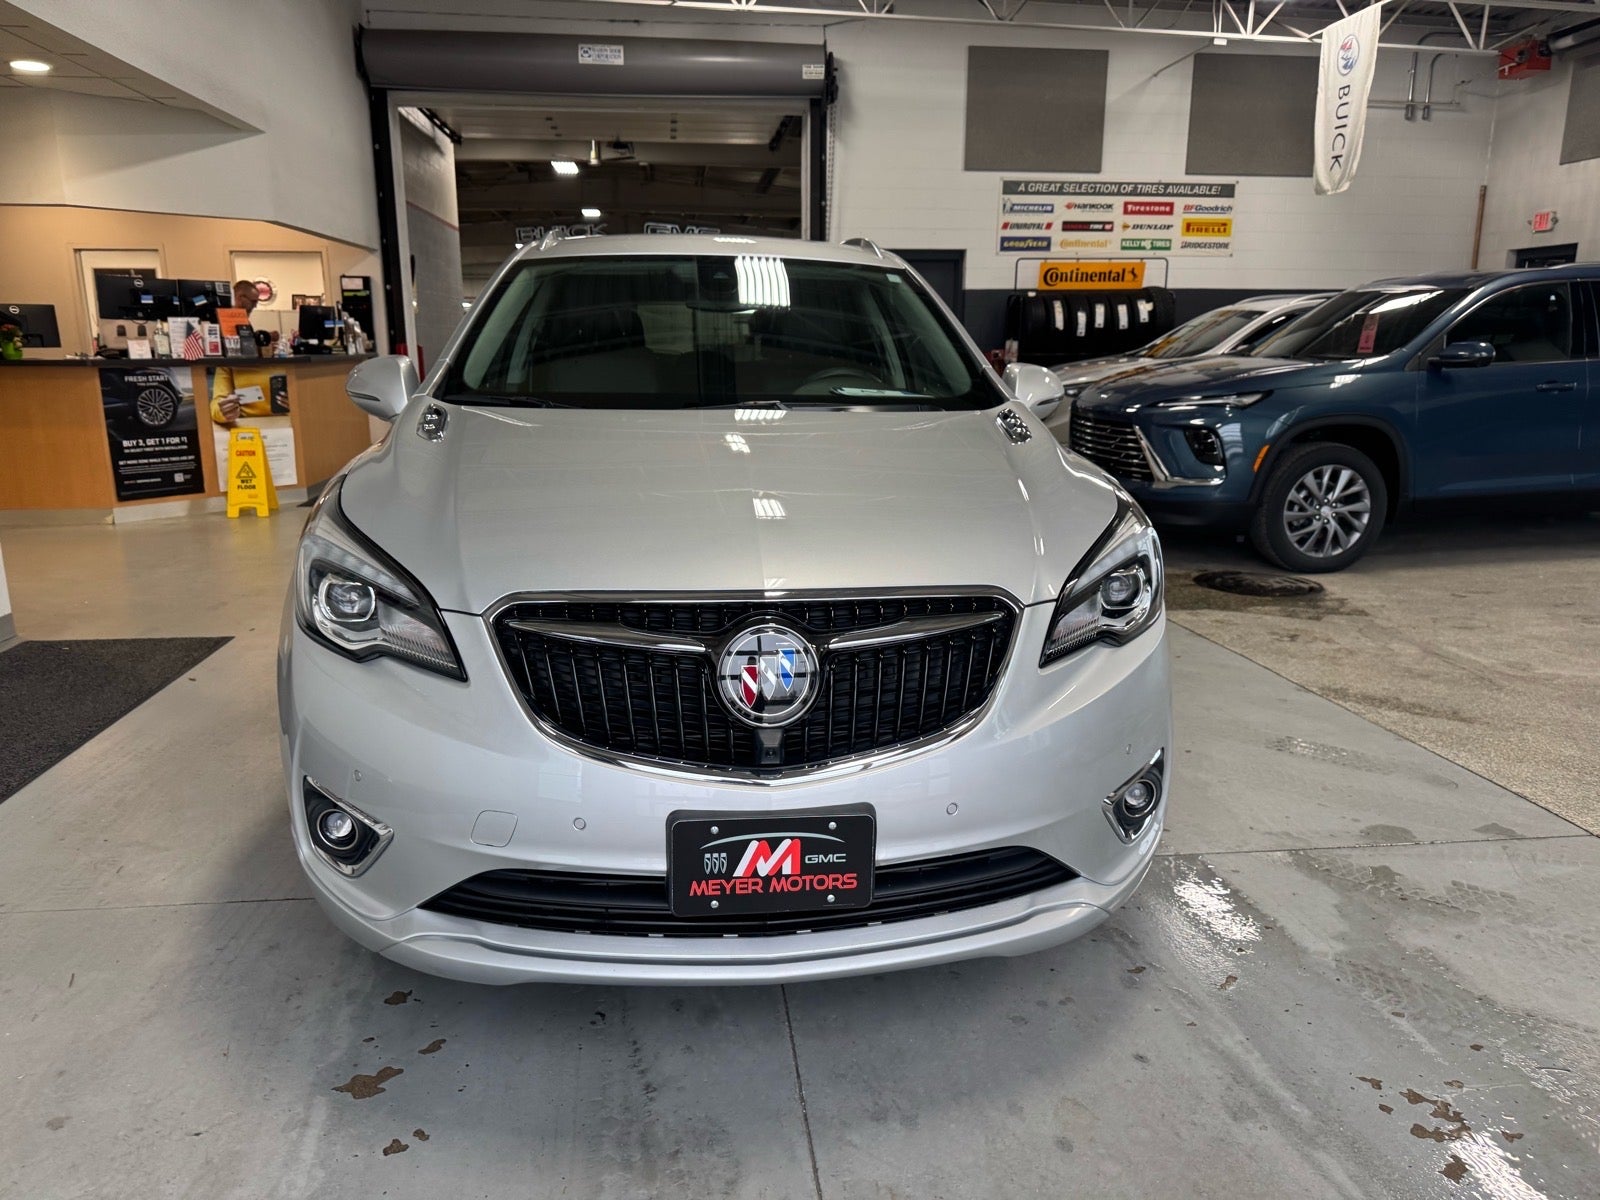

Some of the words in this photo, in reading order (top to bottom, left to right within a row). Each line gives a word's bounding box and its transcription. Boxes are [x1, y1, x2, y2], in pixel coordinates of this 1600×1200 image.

[1329, 84, 1351, 172] BUICK
[1017, 183, 1026, 192] A
[1028, 183, 1061, 193] GREAT
[1062, 183, 1119, 193] SELECTION
[1120, 184, 1135, 194] OF
[1136, 184, 1165, 194] TIRES
[1165, 185, 1221, 195] AVAILABLE!
[1126, 204, 1171, 213] Firestone
[1183, 204, 1233, 213] BFGoodrich
[1009, 222, 1045, 230] UNIROYAL
[1186, 222, 1228, 233] PIRELLI
[1181, 241, 1229, 249] BRIDGESTONE
[1042, 266, 1126, 287] Continental
[122, 439, 137, 447] BUY
[138, 439, 146, 447] 3,
[146, 438, 160, 446] GET
[805, 853, 847, 864] GMC
[689, 878, 764, 897] MEYER
[769, 873, 858, 894] MOTORS
